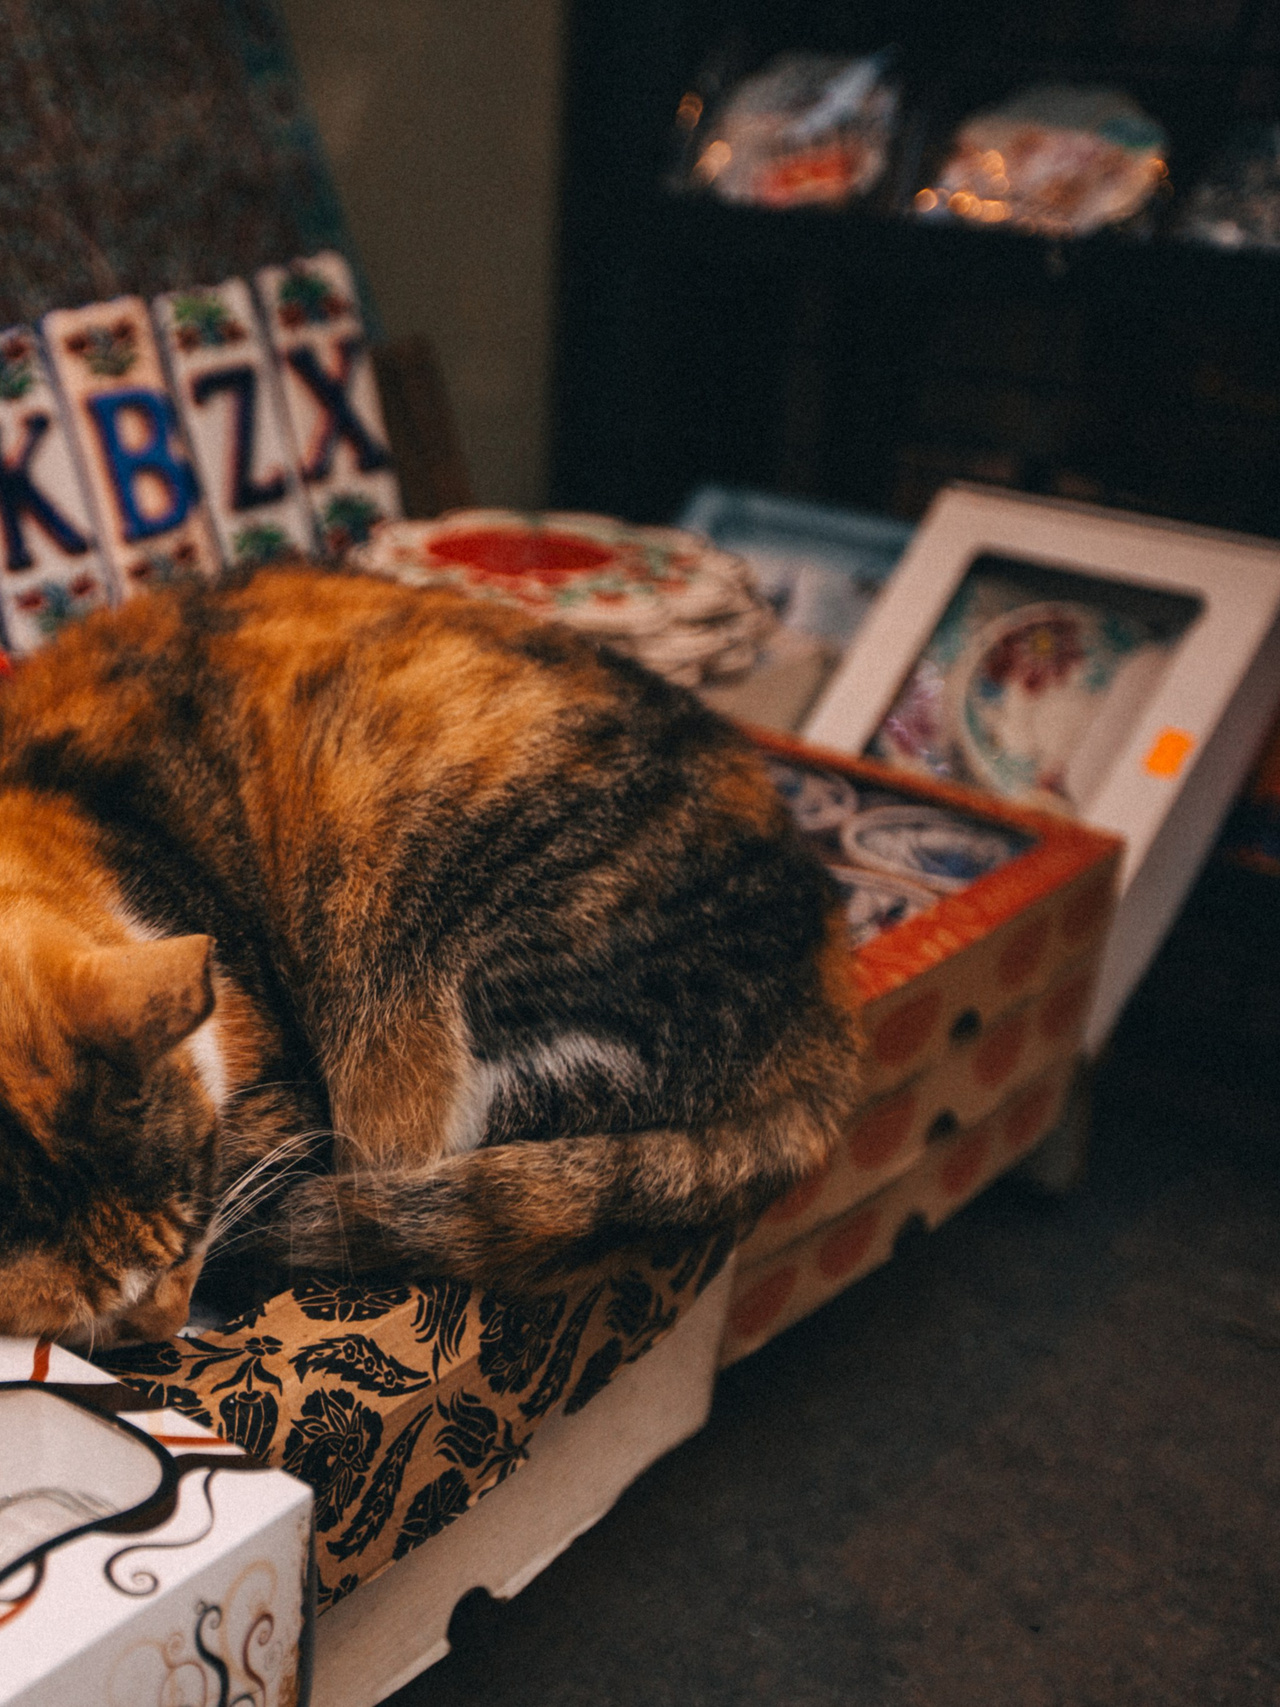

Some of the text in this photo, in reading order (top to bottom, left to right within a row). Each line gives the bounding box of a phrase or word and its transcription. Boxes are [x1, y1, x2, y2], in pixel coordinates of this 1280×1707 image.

[88, 388, 203, 543] B
[189, 364, 288, 512] Z
[282, 334, 390, 483] X
